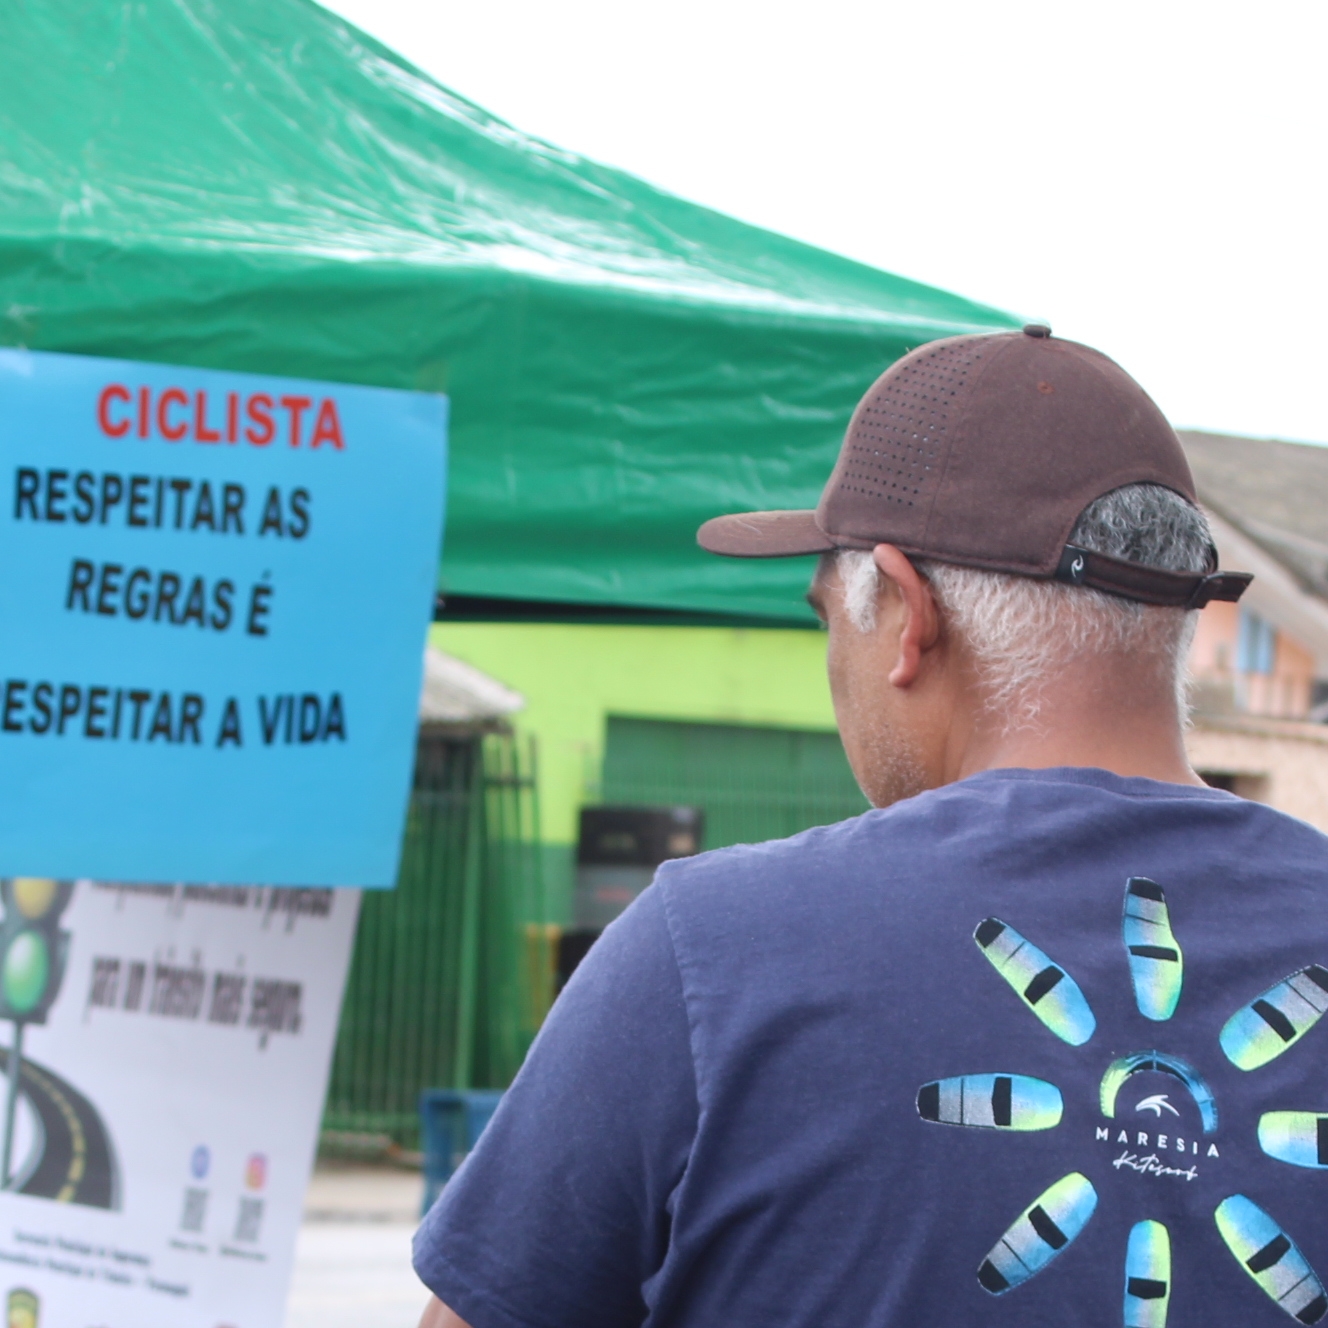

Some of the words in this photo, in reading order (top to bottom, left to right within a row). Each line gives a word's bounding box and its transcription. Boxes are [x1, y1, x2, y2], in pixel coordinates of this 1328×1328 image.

[97, 384, 344, 449] CICLISTA
[12, 465, 246, 536] RESPEITAR
[258, 485, 312, 540] AS
[65, 557, 236, 632] REGRAS
[246, 571, 274, 636] É
[215, 696, 243, 749] A
[257, 692, 347, 745] VIDA
[1095, 1126, 1220, 1158] MARESIA
